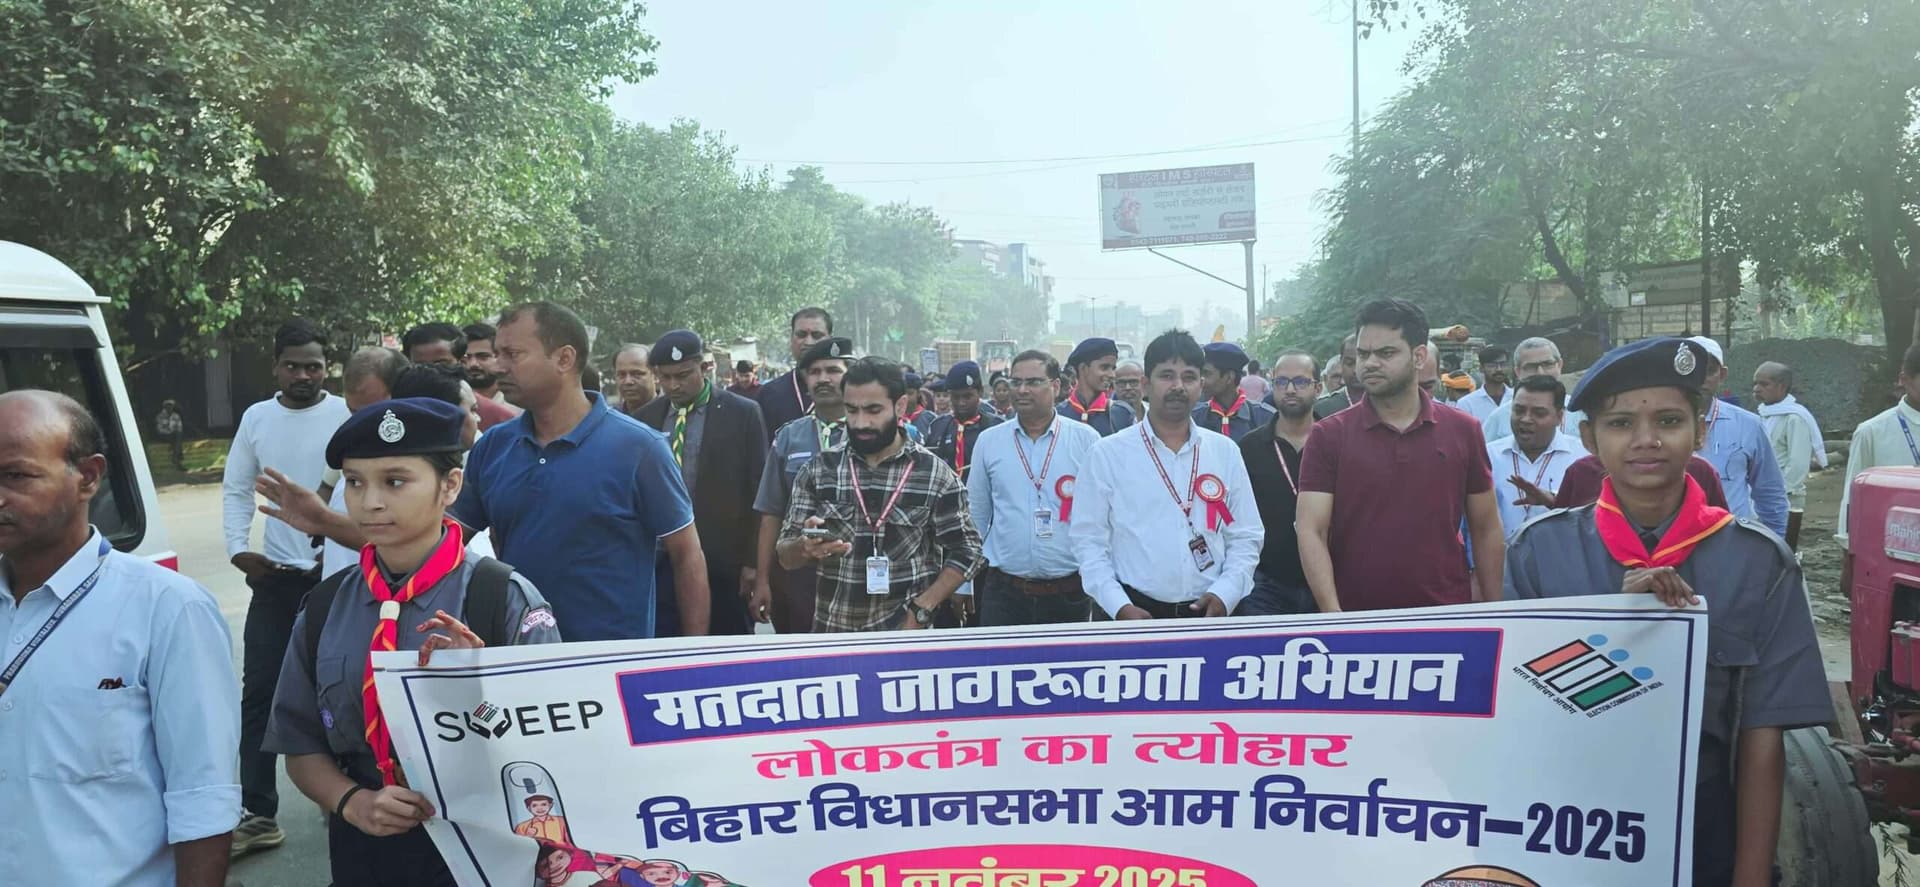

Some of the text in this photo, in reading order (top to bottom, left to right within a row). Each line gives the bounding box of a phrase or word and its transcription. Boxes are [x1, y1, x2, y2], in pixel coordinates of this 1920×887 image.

[644, 637, 1464, 730] मतदाता जागरूकता अभियान
[1513, 667, 1530, 681] भारत
[1553, 697, 1577, 715] आयोग
[1586, 704, 1611, 718] ELECTION
[1648, 681, 1664, 691] INDIA
[434, 700, 603, 742] SWEEP
[751, 721, 1352, 780] लोकतंत्र का त्योहार
[637, 795, 802, 849] बिहार
[806, 781, 1103, 831] विधानसभा
[1111, 788, 1240, 828] आम
